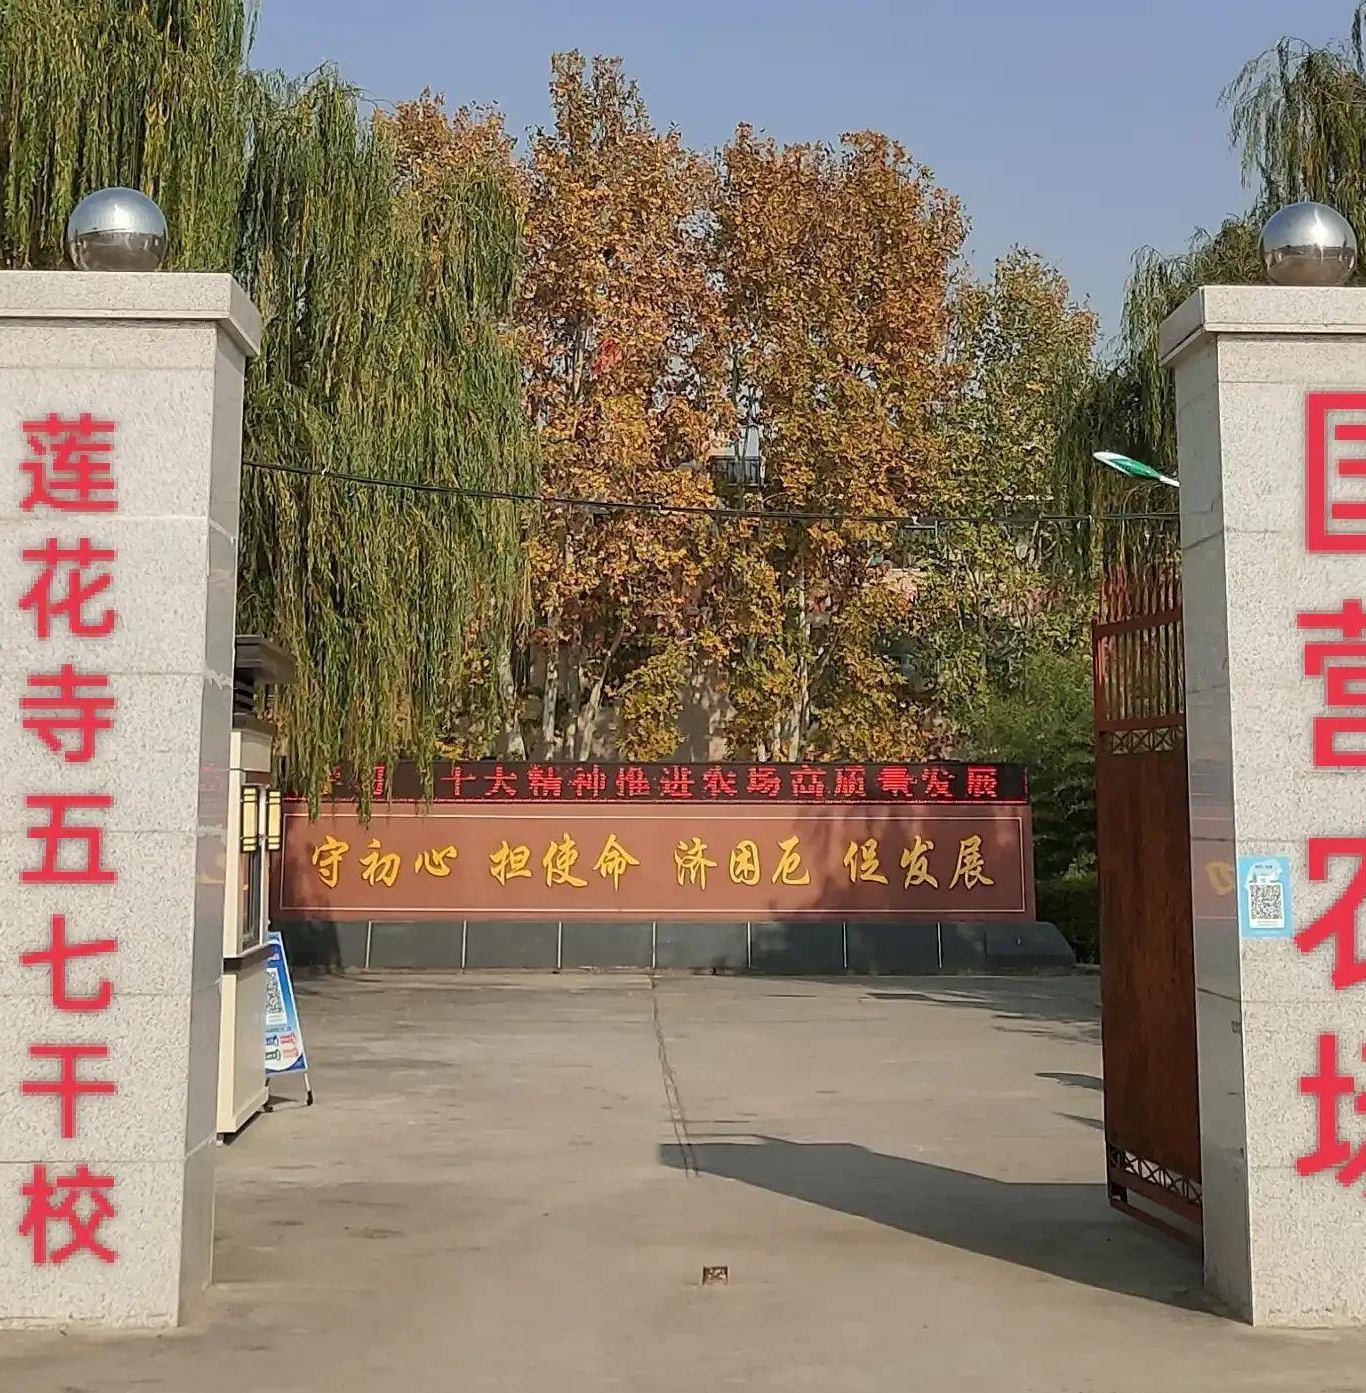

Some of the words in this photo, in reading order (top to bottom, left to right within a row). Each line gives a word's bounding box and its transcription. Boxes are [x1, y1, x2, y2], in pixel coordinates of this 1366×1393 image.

[312, 835, 458, 889] 守初心
[488, 832, 640, 892] 担使命
[843, 834, 995, 890] 促发展
